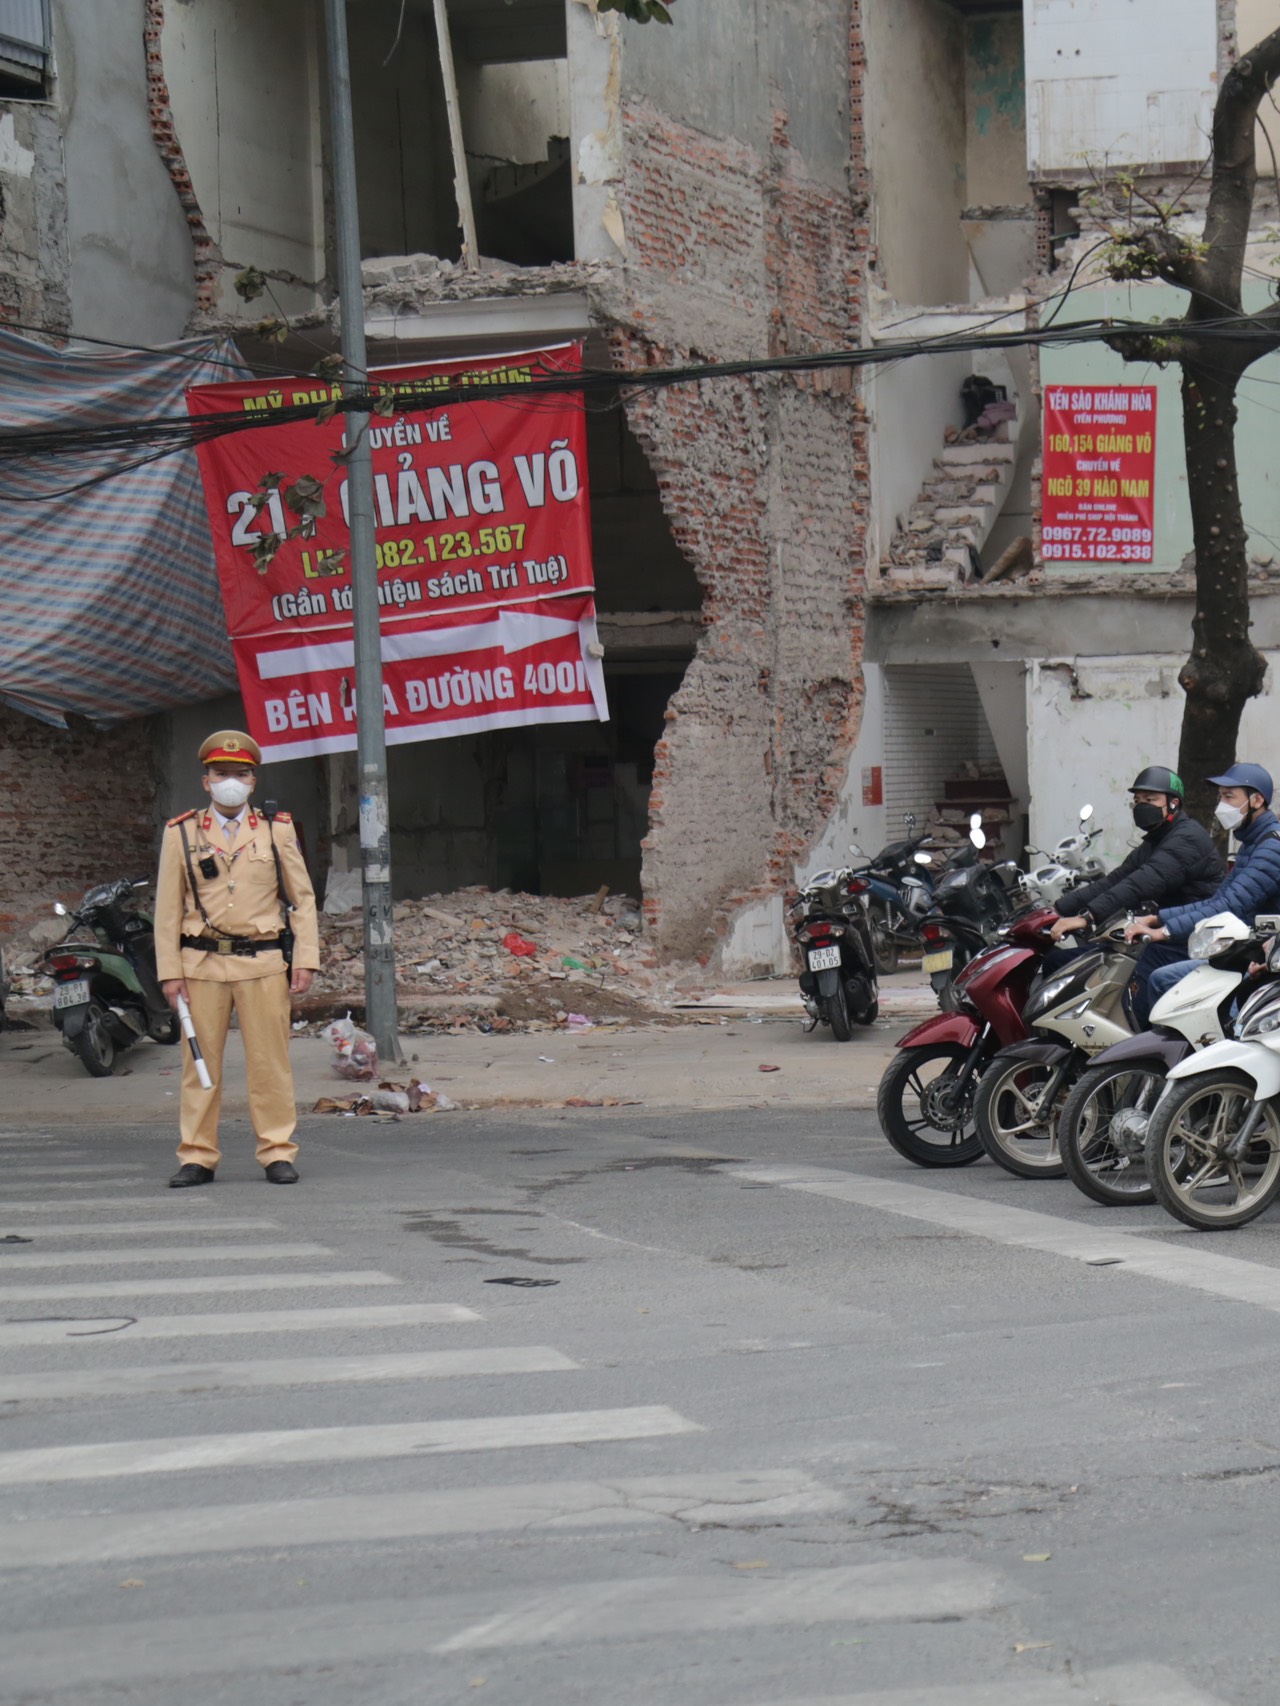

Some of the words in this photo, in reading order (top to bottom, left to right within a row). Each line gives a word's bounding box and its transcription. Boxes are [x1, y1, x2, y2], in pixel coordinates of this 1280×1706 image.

[1049, 387, 1070, 411] YẾN
[1071, 390, 1092, 411] SÀO
[1094, 390, 1129, 411] KHÁNH
[425, 414, 452, 442] VỀ
[1096, 427, 1133, 453] GIẢNG
[1136, 431, 1152, 454] VÕ
[514, 438, 580, 508] VÕ
[1048, 475, 1073, 497] NGÕ
[1075, 478, 1091, 497] 39
[1094, 475, 1118, 497] HÀO
[1121, 479, 1149, 498] NAM
[1042, 526, 1152, 543] 0967.72.9089
[1042, 543, 1152, 560] 0915.102.338
[272, 586, 328, 622] (Gần
[428, 565, 483, 597] sách
[488, 560, 519, 591] Trí
[522, 553, 568, 586] Tuệ)
[264, 688, 333, 734] BÊN
[405, 666, 515, 714] ĐƯỜNG
